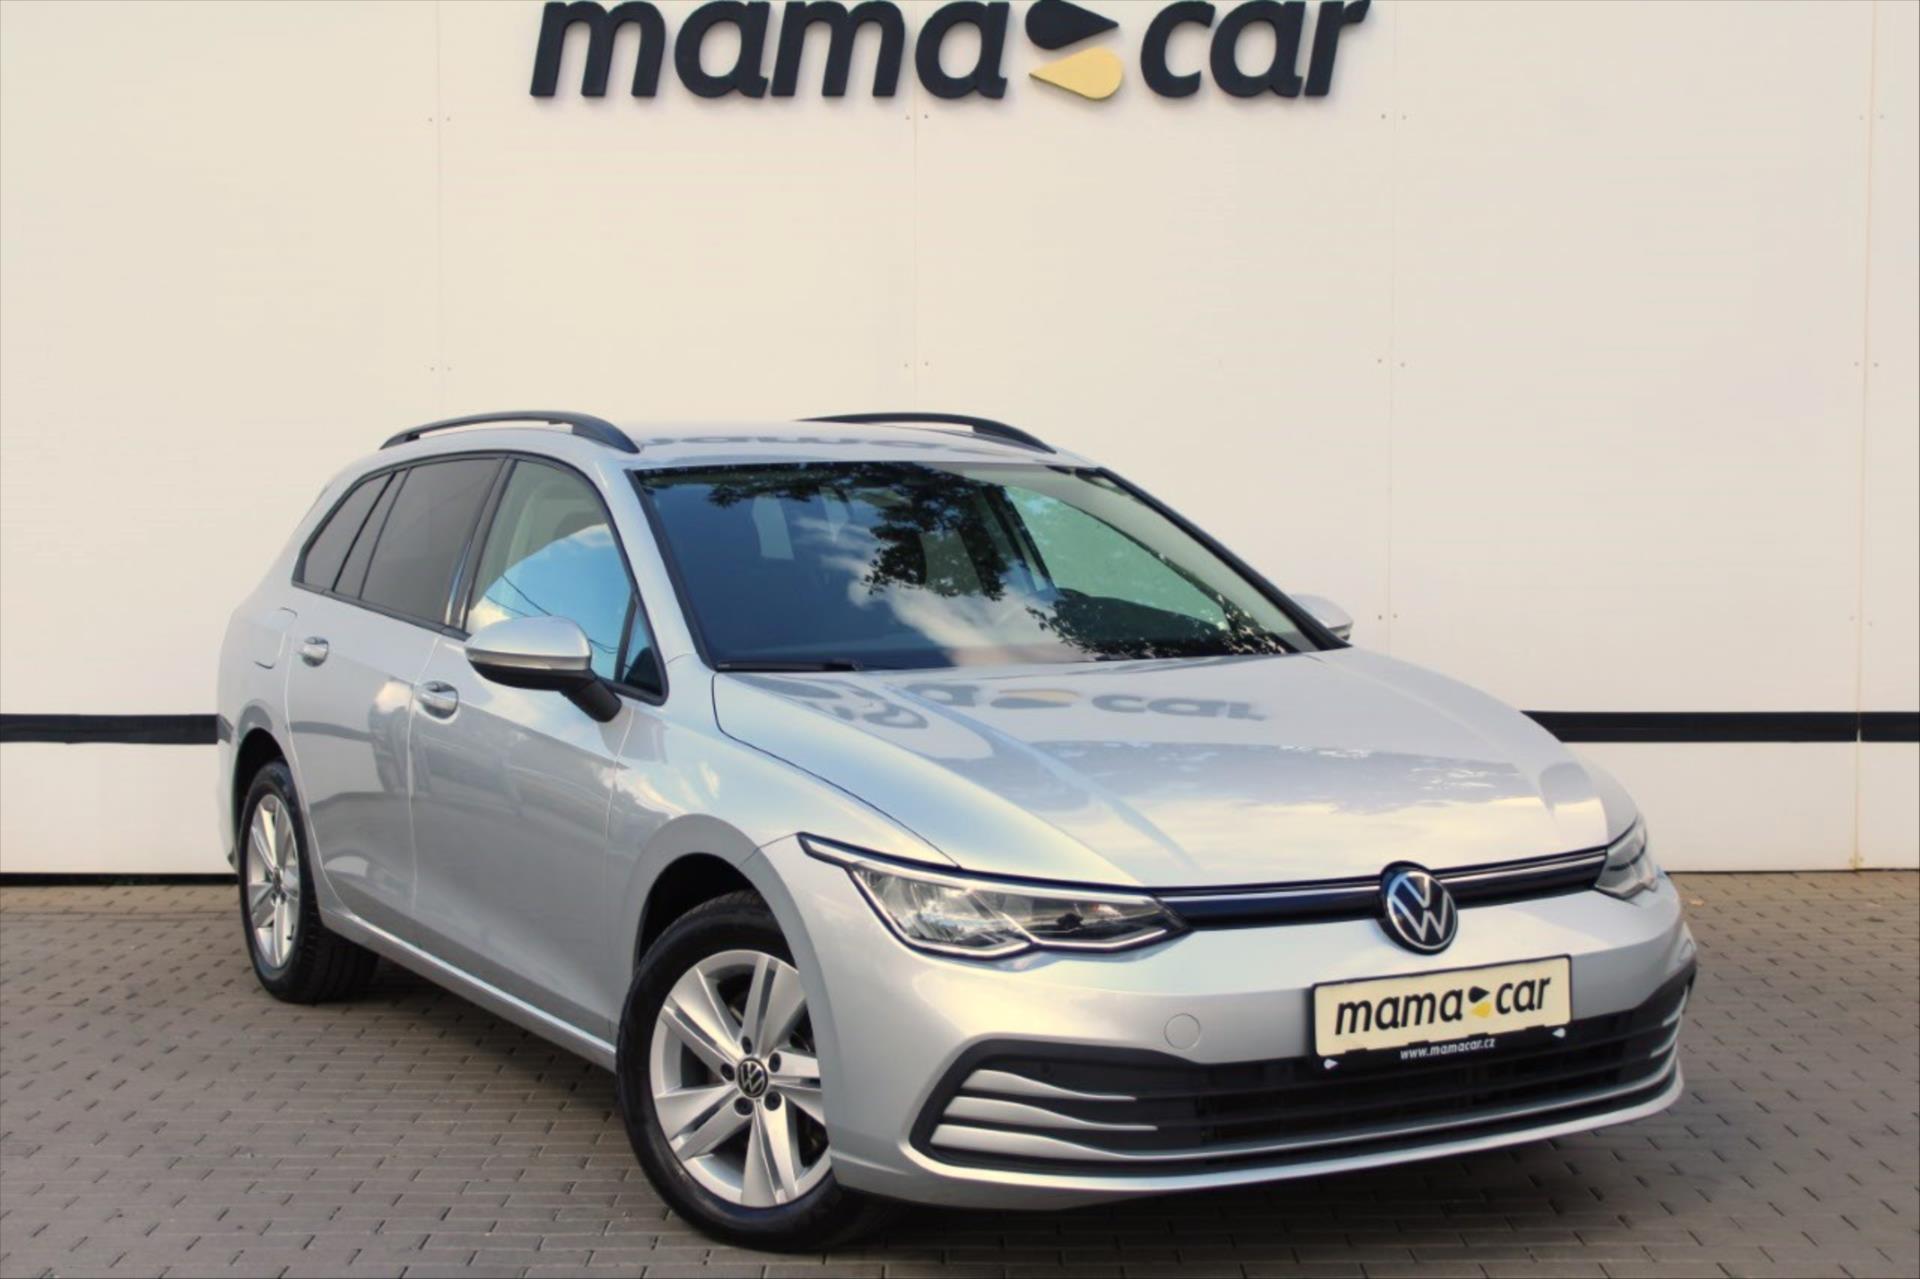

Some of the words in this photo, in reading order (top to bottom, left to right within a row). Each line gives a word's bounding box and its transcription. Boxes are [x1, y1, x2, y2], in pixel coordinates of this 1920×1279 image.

[530, 0, 1008, 99] mama
[1140, 0, 1371, 99] car
[1335, 988, 1464, 1036] mama
[1495, 976, 1551, 1015] car
[1400, 1038, 1496, 1060] www.mamacar.cz
